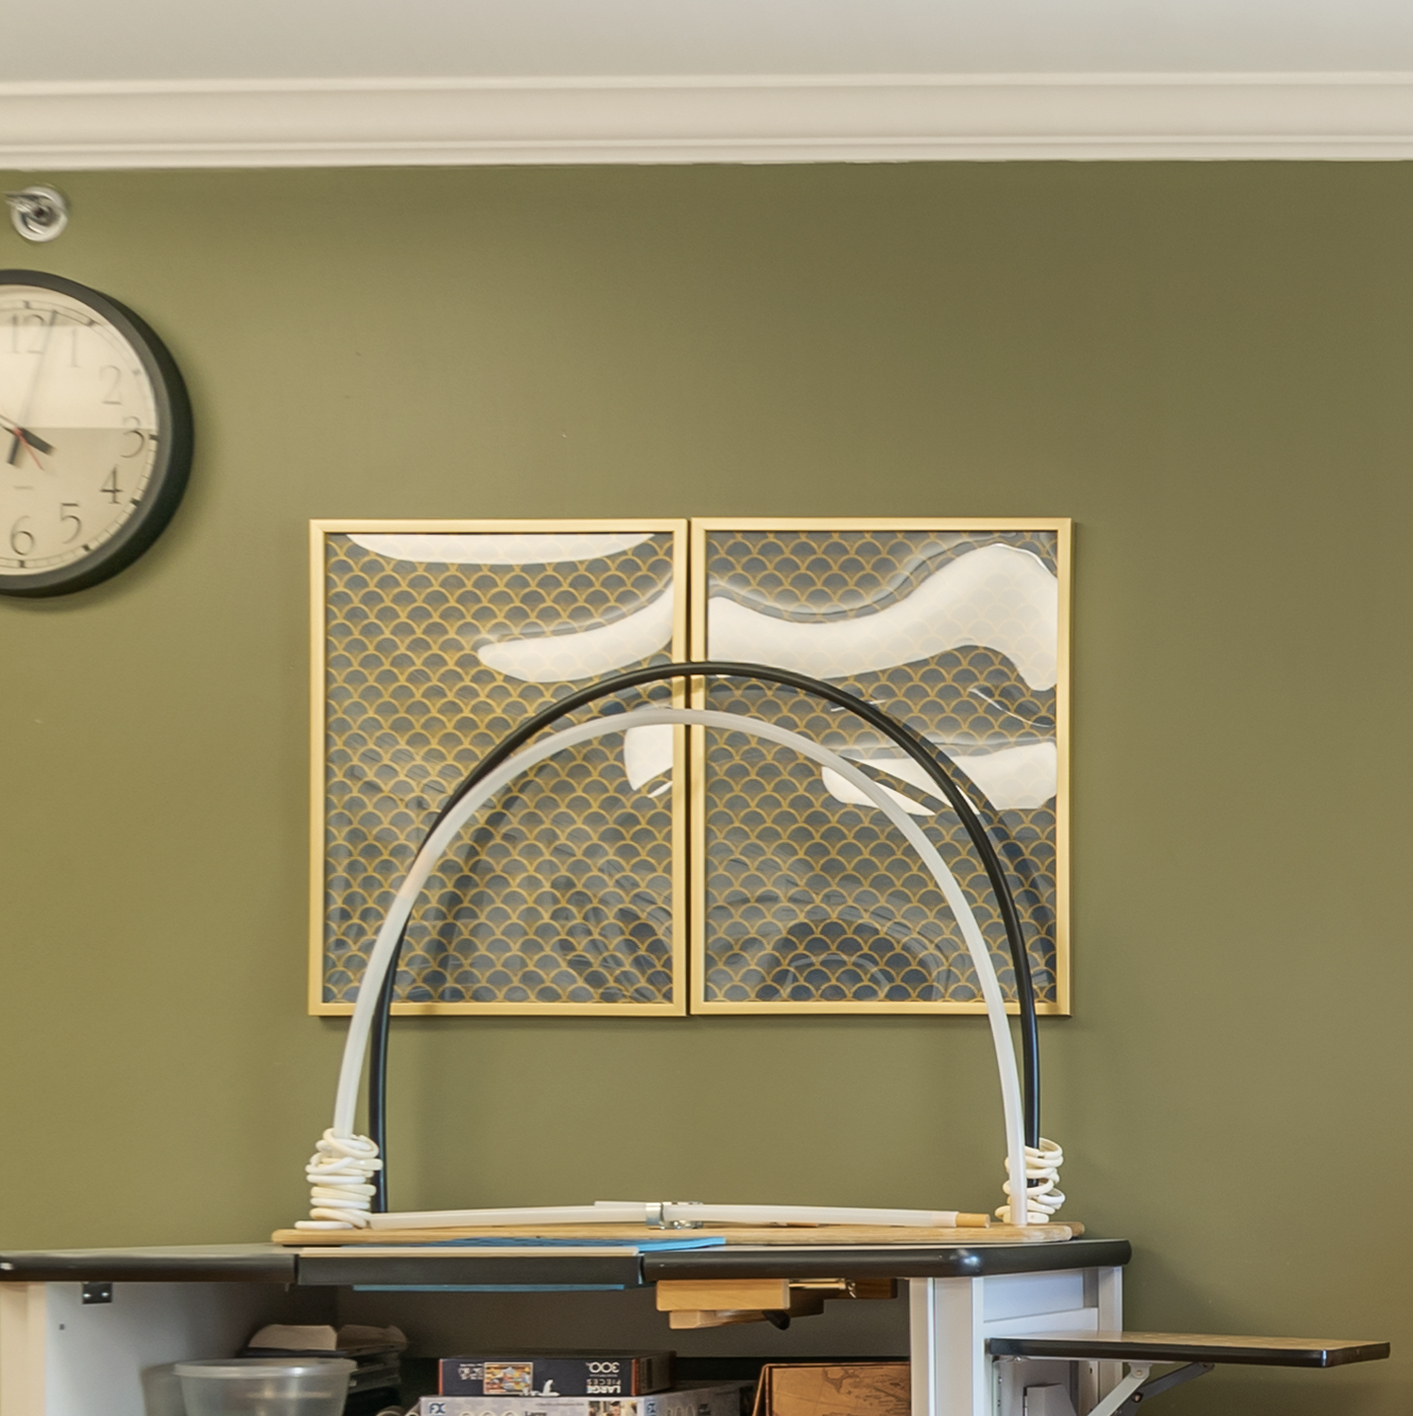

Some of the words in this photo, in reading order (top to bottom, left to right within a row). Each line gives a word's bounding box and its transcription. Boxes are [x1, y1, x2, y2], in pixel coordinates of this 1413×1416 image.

[11, 313, 45, 355] 12
[71, 327, 81, 368] 1
[100, 364, 123, 405] 2
[120, 416, 145, 458] 3
[99, 466, 124, 505] 4
[9, 515, 35, 556] 6
[60, 502, 82, 544] 5
[586, 1386, 621, 1394] LARGE
